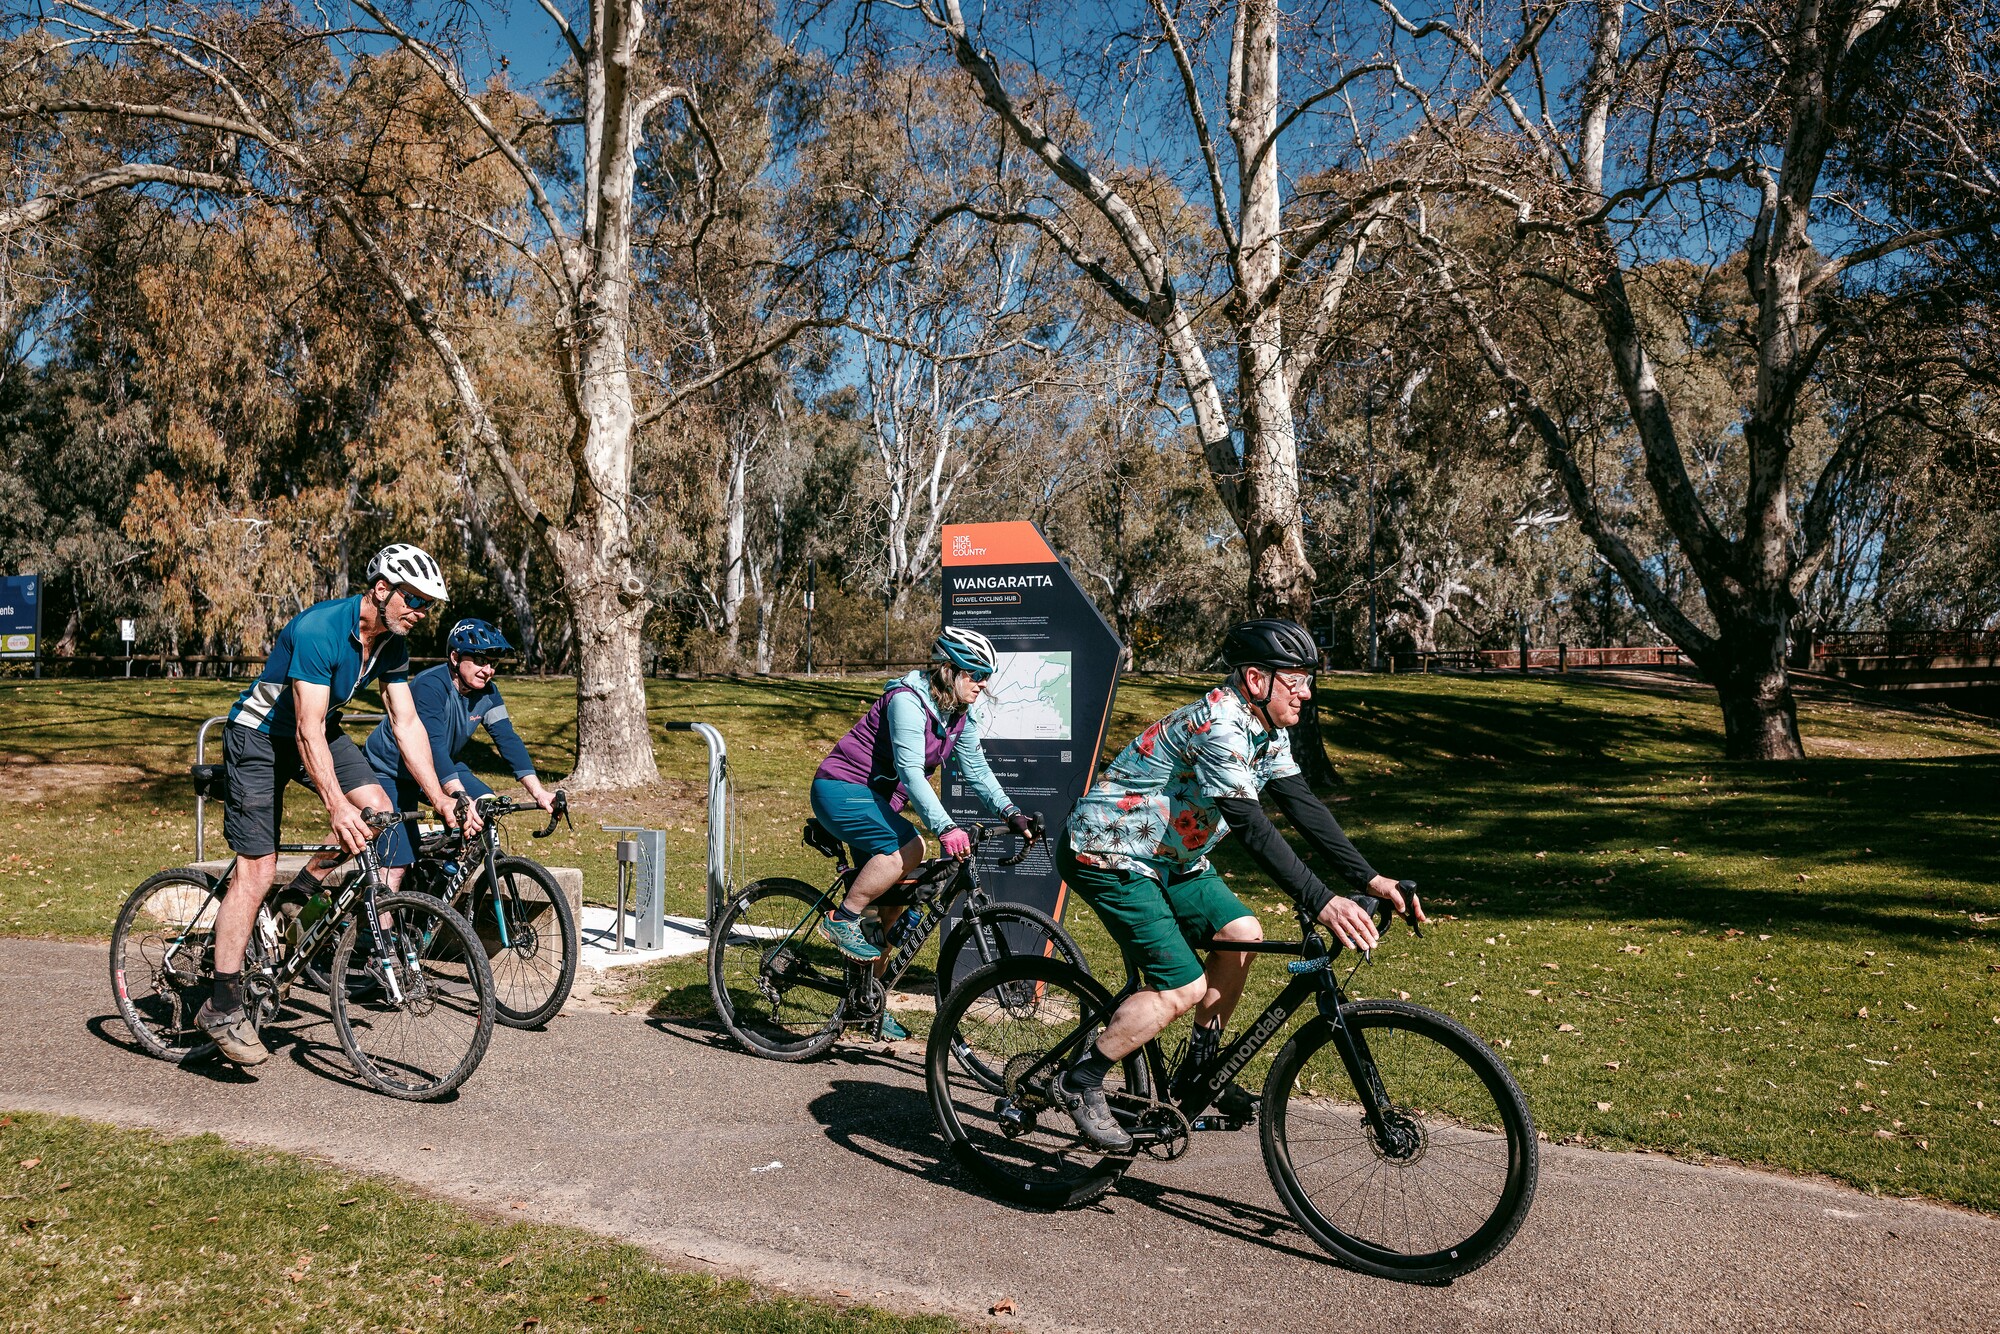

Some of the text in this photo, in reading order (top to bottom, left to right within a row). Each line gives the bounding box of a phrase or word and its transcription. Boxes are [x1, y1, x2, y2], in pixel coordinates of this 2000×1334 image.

[953, 535, 970, 543] RIDE
[952, 548, 987, 557] COUNTRY
[953, 575, 1053, 590] WANGARATTA
[0, 605, 14, 616] ents
[287, 889, 355, 975] FOCUS
[364, 901, 383, 951] FOCUS
[1208, 1007, 1287, 1091] cannondale
